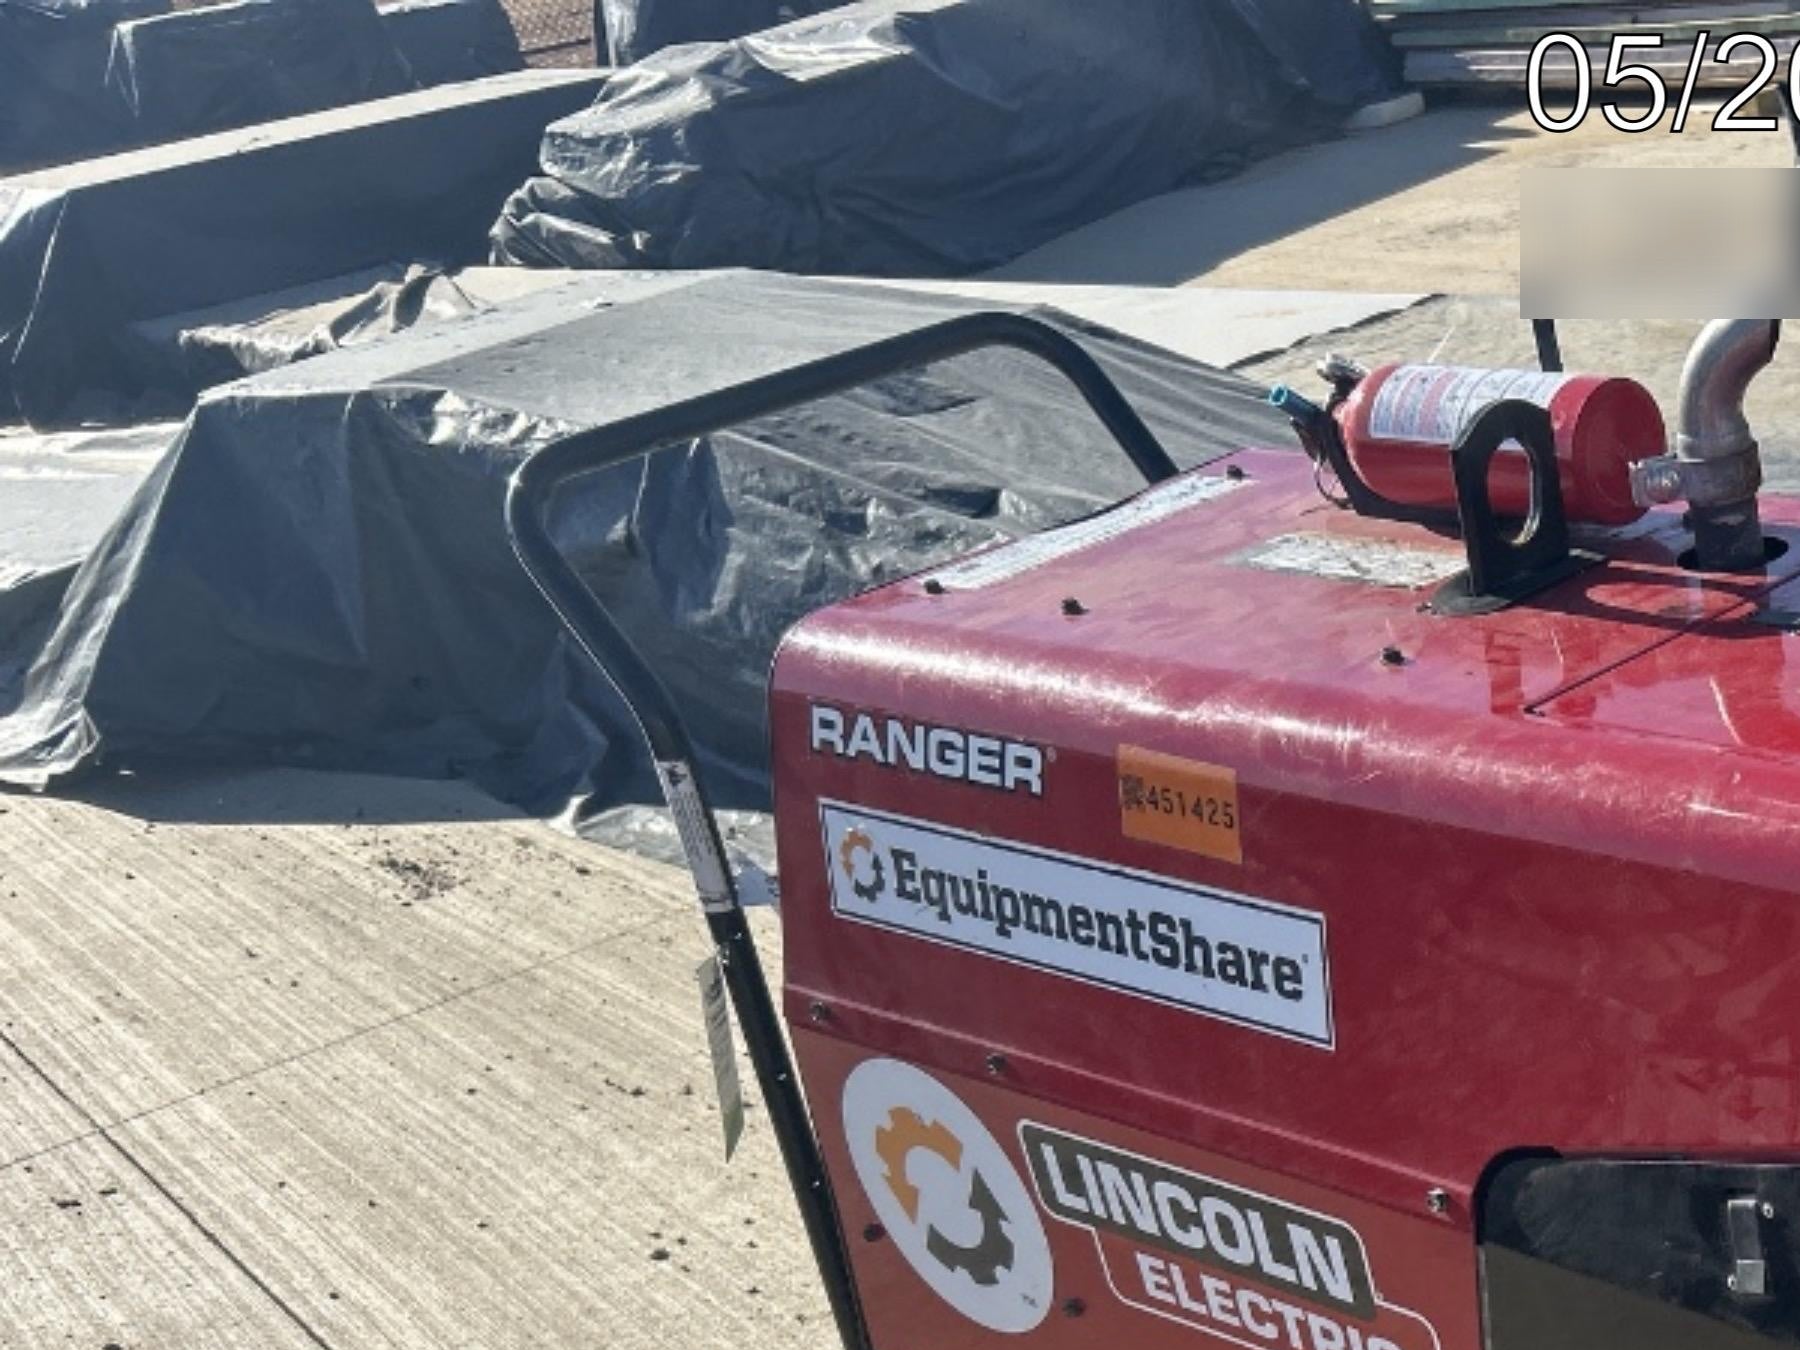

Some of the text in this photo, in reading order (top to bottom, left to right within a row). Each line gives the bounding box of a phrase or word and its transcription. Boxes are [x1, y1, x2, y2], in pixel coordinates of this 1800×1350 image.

[811, 704, 1043, 796] RANGER
[1145, 785, 1234, 829] 451425
[890, 848, 1304, 1001] EquipmentShare
[1040, 1142, 1355, 1302] LINCOLN
